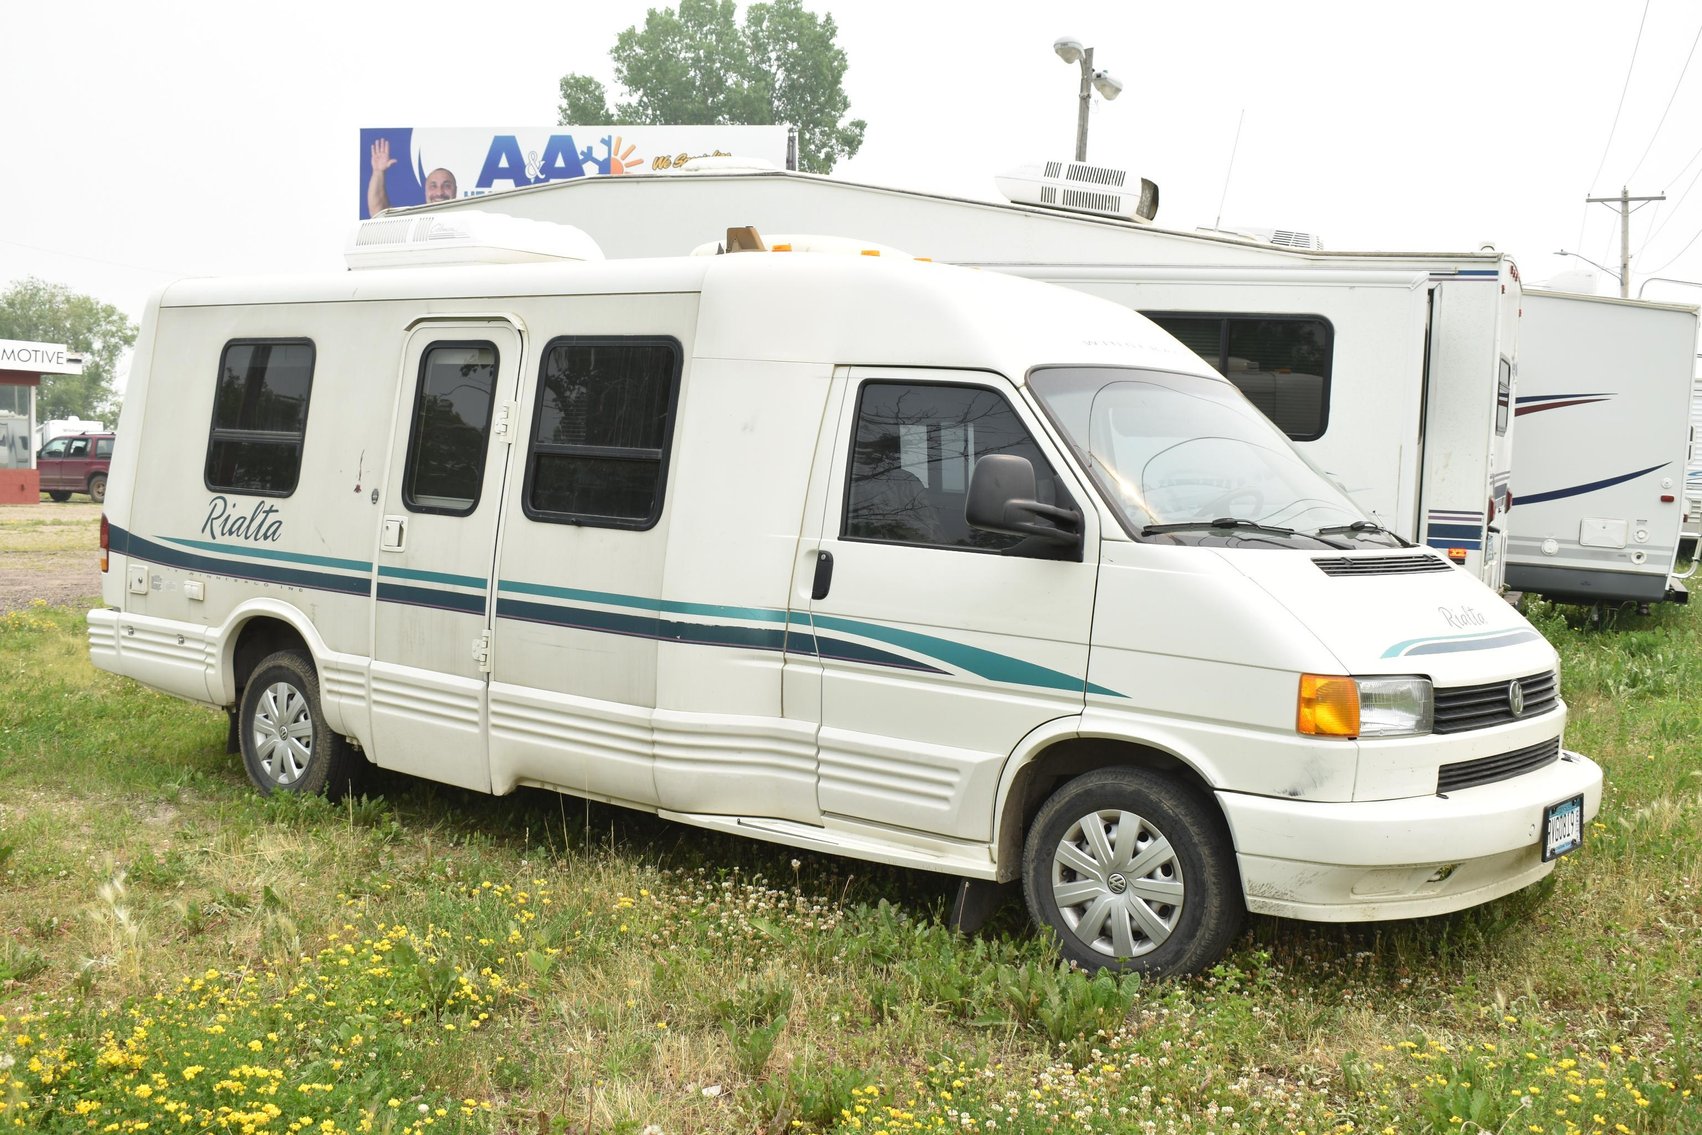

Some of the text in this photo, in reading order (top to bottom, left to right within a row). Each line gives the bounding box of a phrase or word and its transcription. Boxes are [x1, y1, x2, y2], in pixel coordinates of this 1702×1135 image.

[475, 134, 585, 188] A&A
[652, 154, 672, 171] We
[1, 348, 64, 365] MOTIVE
[201, 495, 283, 542] Rialta
[1437, 606, 1487, 629] Rialta
